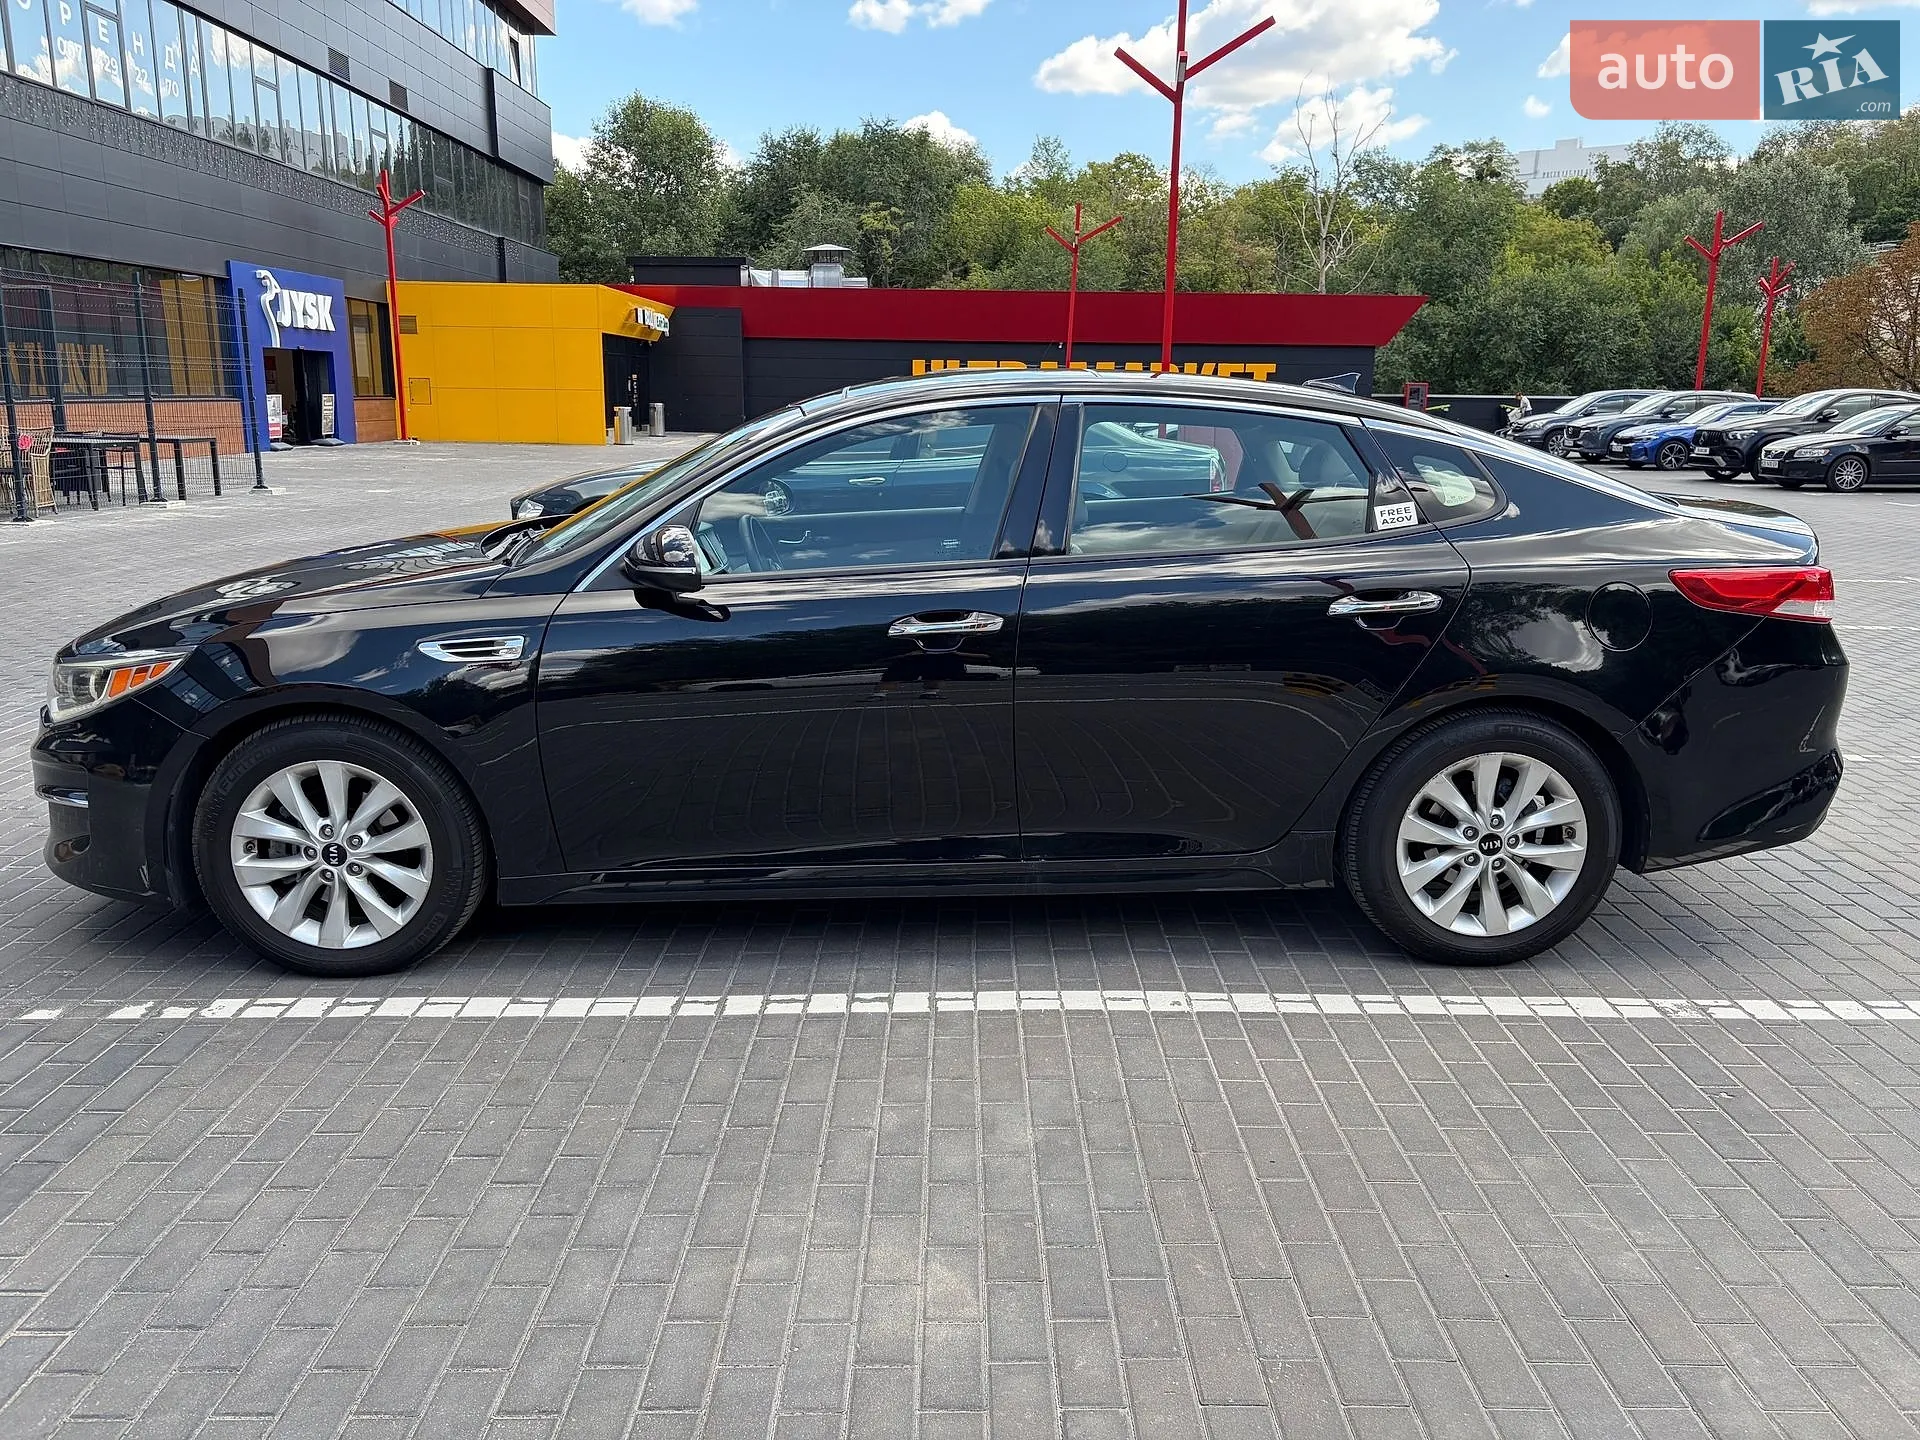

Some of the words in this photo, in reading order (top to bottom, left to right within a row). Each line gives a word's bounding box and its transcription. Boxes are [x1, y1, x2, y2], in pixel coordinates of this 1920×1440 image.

[277, 289, 335, 331] JYSK
[1379, 506, 1412, 517] FREE
[1381, 515, 1412, 525] AZOV
[1481, 840, 1501, 851] KIA
[329, 845, 339, 865] KIA
